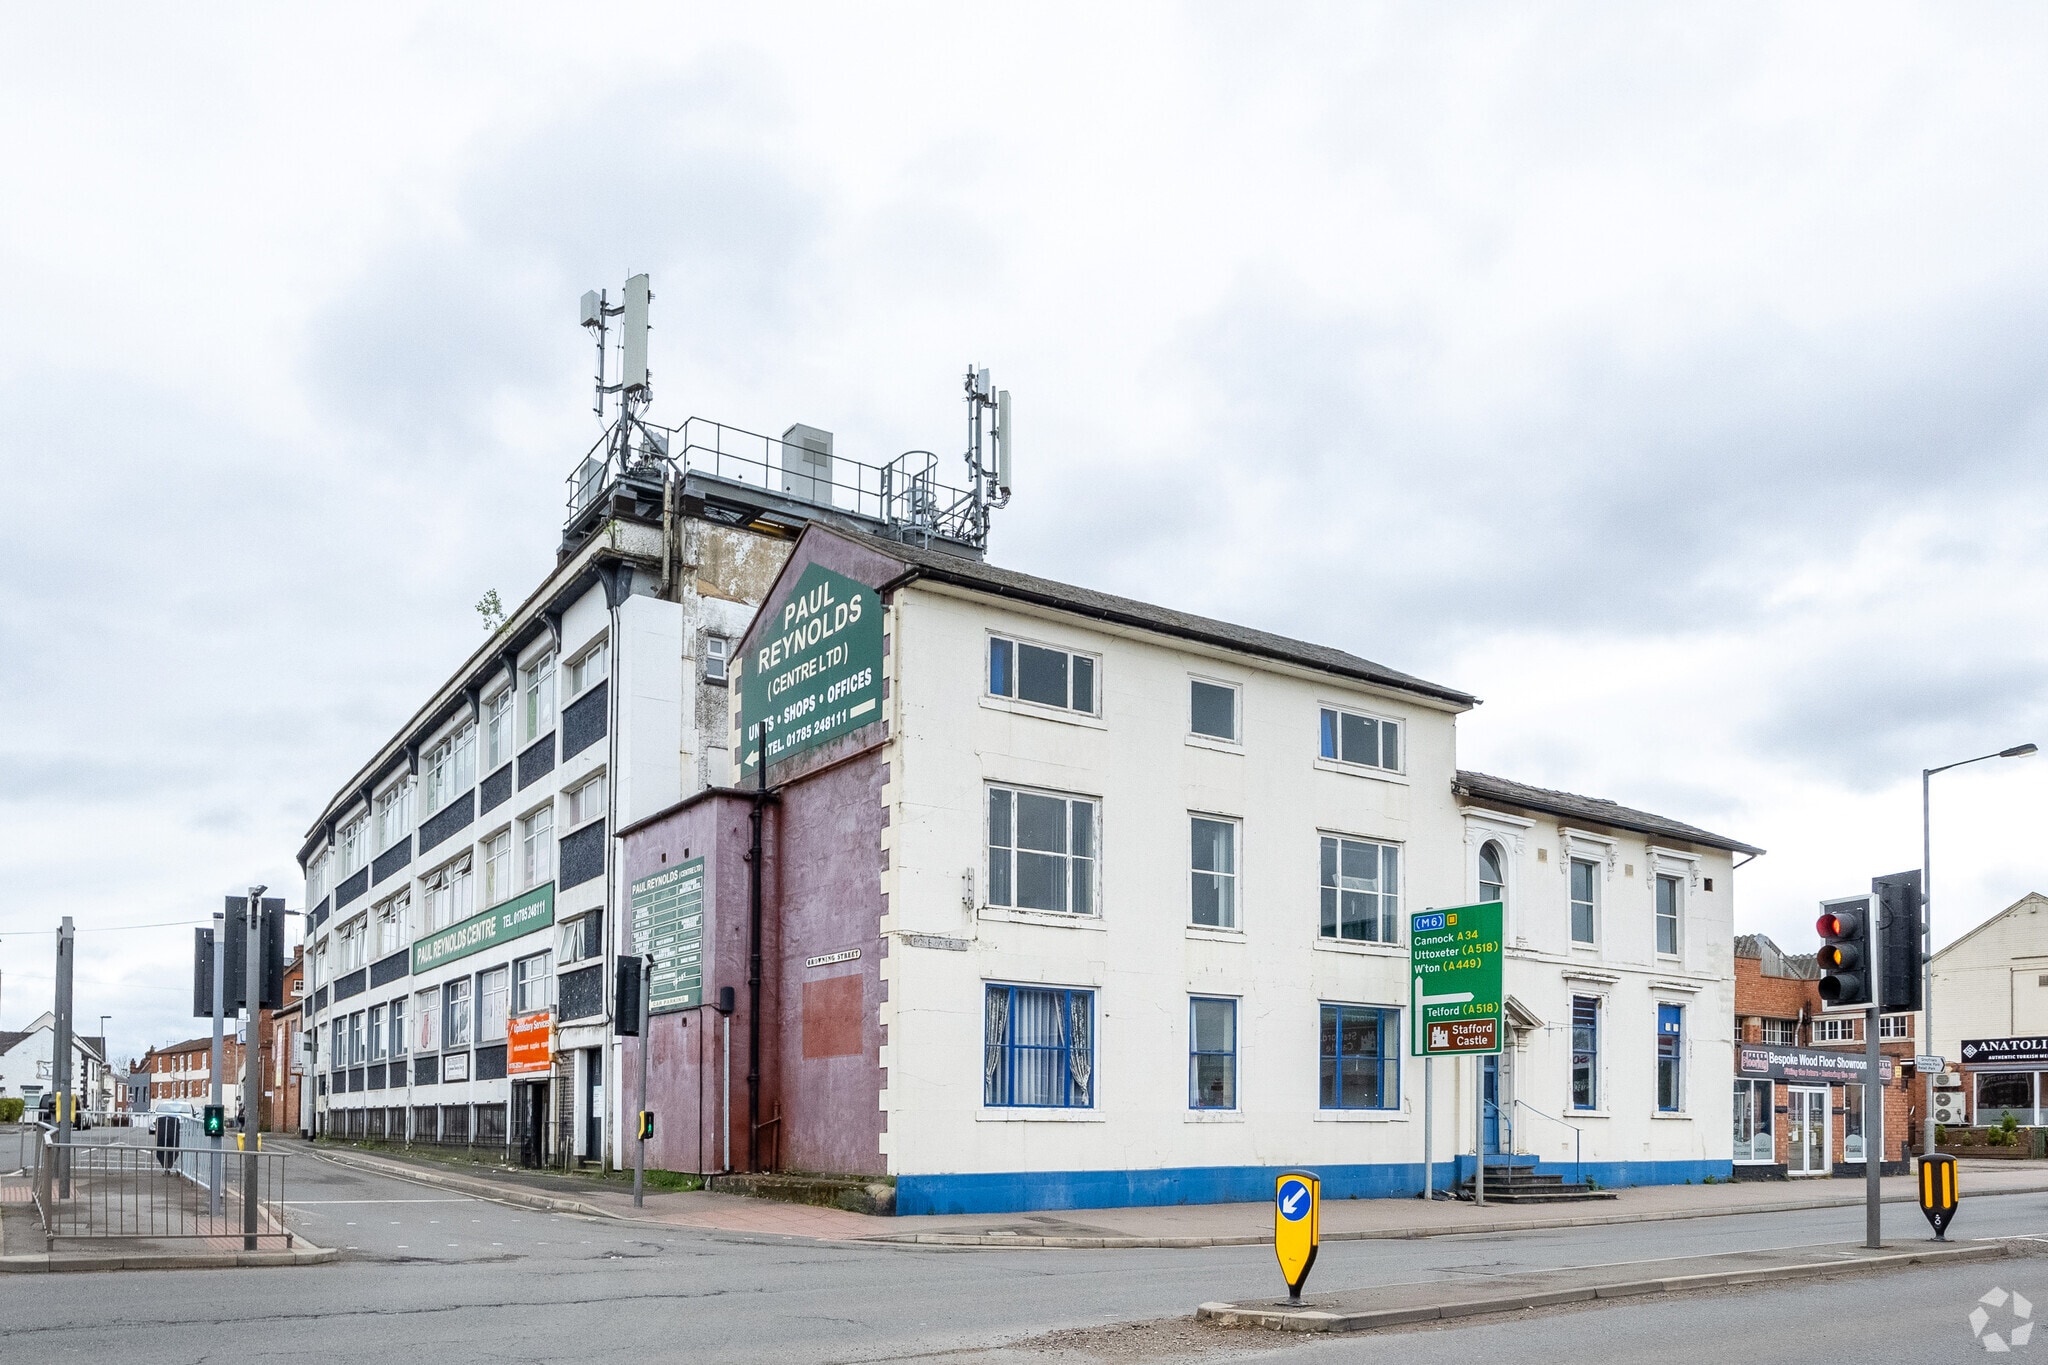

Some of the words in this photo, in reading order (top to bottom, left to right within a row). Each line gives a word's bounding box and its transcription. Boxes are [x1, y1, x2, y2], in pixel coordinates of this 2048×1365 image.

[784, 581, 835, 630] PAUL
[758, 594, 862, 674] REYNOLDS
[767, 656, 819, 702] (CENTRE
[818, 642, 849, 673] LTD)
[748, 715, 775, 741] UNTS
[783, 695, 816, 724] SHOPS
[827, 668, 872, 703] OFFICES
[767, 738, 785, 756] TEL.
[786, 727, 812, 748] 01785
[813, 709, 847, 735] 248111
[632, 882, 646, 895] PAUL
[646, 870, 679, 890] REYNOLDS
[417, 945, 433, 966] PAUL
[433, 928, 467, 960] REYNOLDS
[466, 916, 497, 947] CENTRE
[1414, 933, 1454, 946] Cannock
[1457, 930, 1479, 941] A34
[837, 950, 859, 960] STREET
[1414, 947, 1459, 960] Uttoxeter
[1461, 941, 1499, 956] (A518)
[1414, 964, 1440, 974] W'ton
[1442, 958, 1482, 972] (A449)
[1427, 1005, 1460, 1017] Telford
[1462, 1001, 1499, 1015] (A518)
[1452, 1023, 1492, 1035] Stafford
[1456, 1035, 1488, 1047] Castle
[1978, 1039, 2048, 1051] ANATOLI
[1768, 1052, 1798, 1067] Bespoke
[1799, 1053, 1818, 1066] Wood
[1819, 1055, 1836, 1067] Floor
